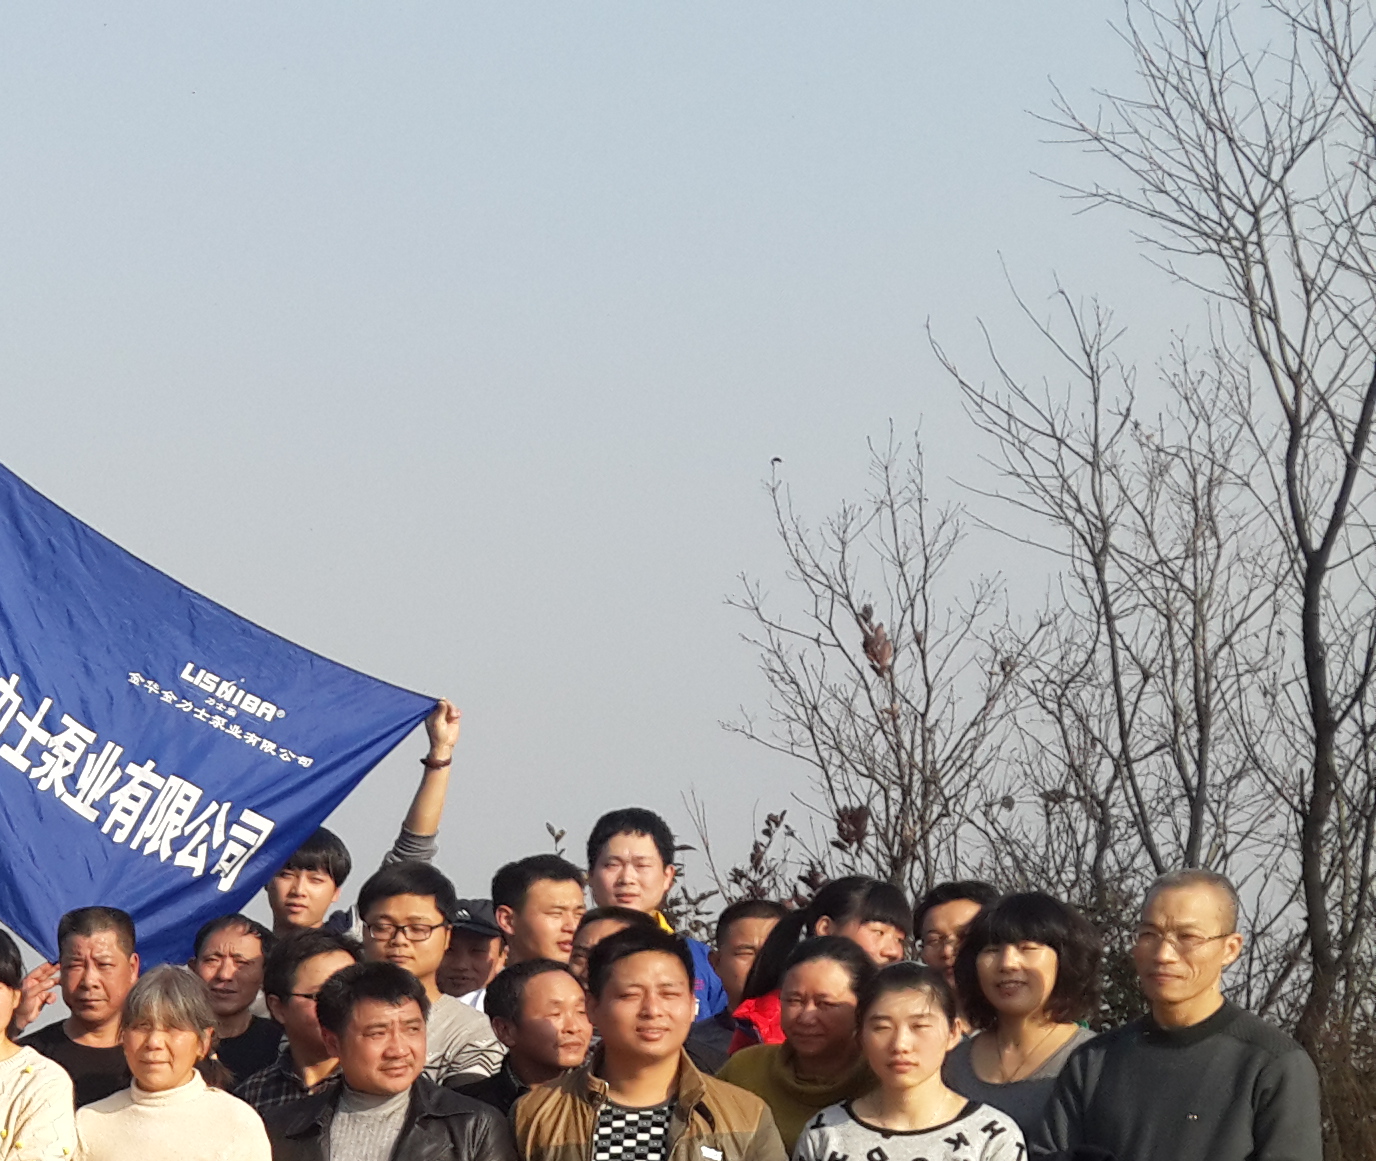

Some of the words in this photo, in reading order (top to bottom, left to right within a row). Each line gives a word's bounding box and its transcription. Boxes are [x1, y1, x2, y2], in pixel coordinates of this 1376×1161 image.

[127, 671, 314, 768] 金华金力士泵业有限公司
